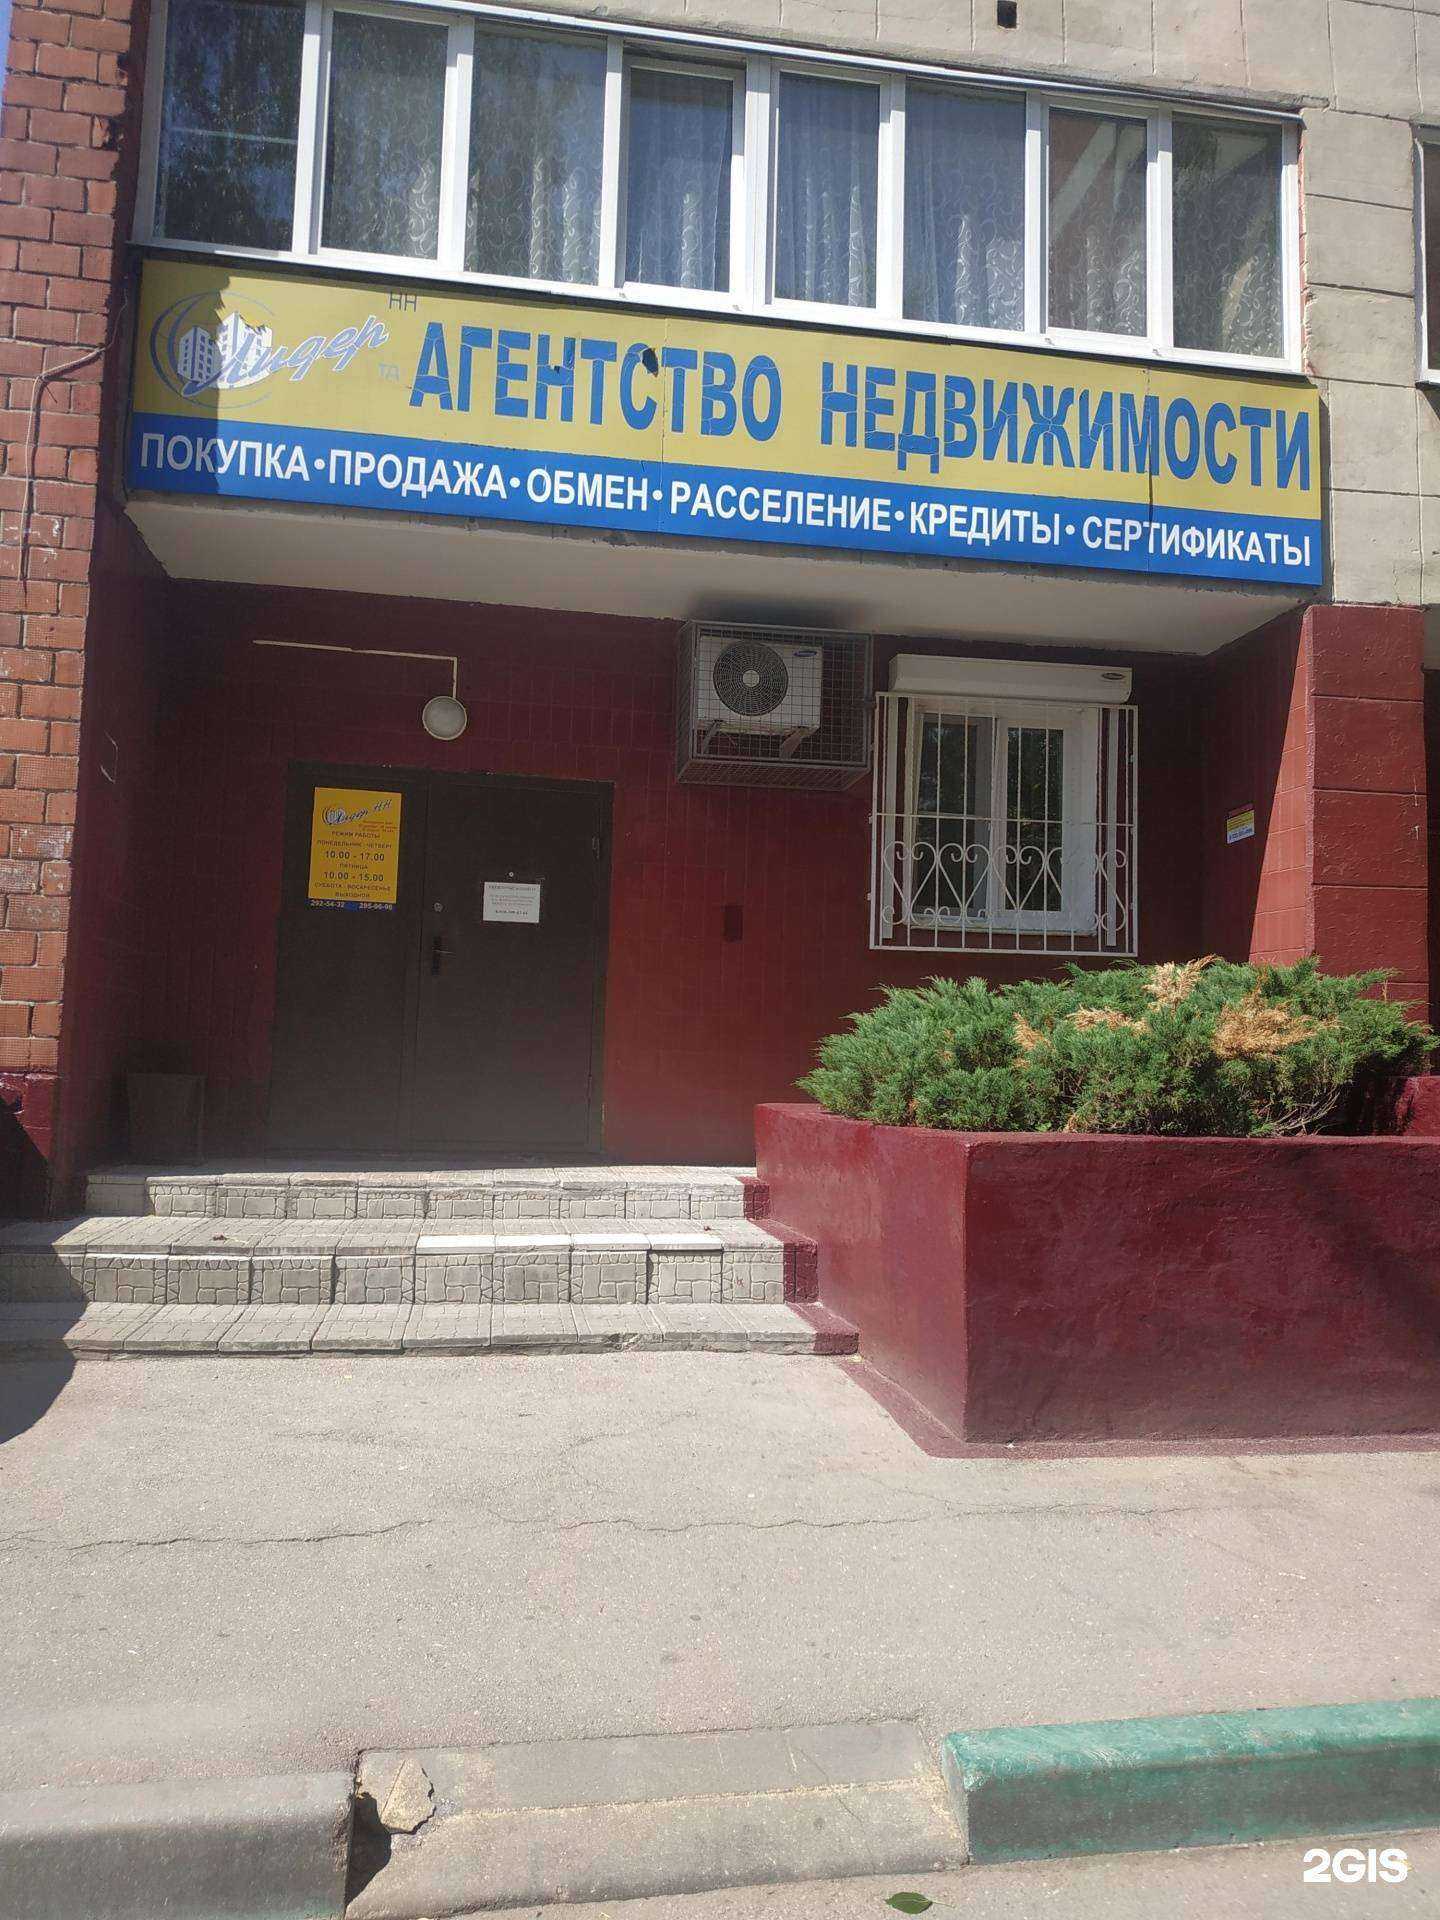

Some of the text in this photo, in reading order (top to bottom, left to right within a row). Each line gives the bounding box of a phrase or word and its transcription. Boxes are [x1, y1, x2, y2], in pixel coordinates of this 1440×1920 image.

[409, 322, 1311, 491] АГЕНТСТВО НЕДВИЖИМОСТИ
[140, 433, 1311, 567] ПОКУПКА ПРОДАЖА ОБМЕН РАССЕЛЕНИЕ КРЕДИТЫ СЕРТИФИКАТЫ
[324, 871, 349, 880] 10.00
[359, 873, 384, 882] 15.00
[325, 850, 351, 859] 10.00
[360, 852, 385, 861] 17.00
